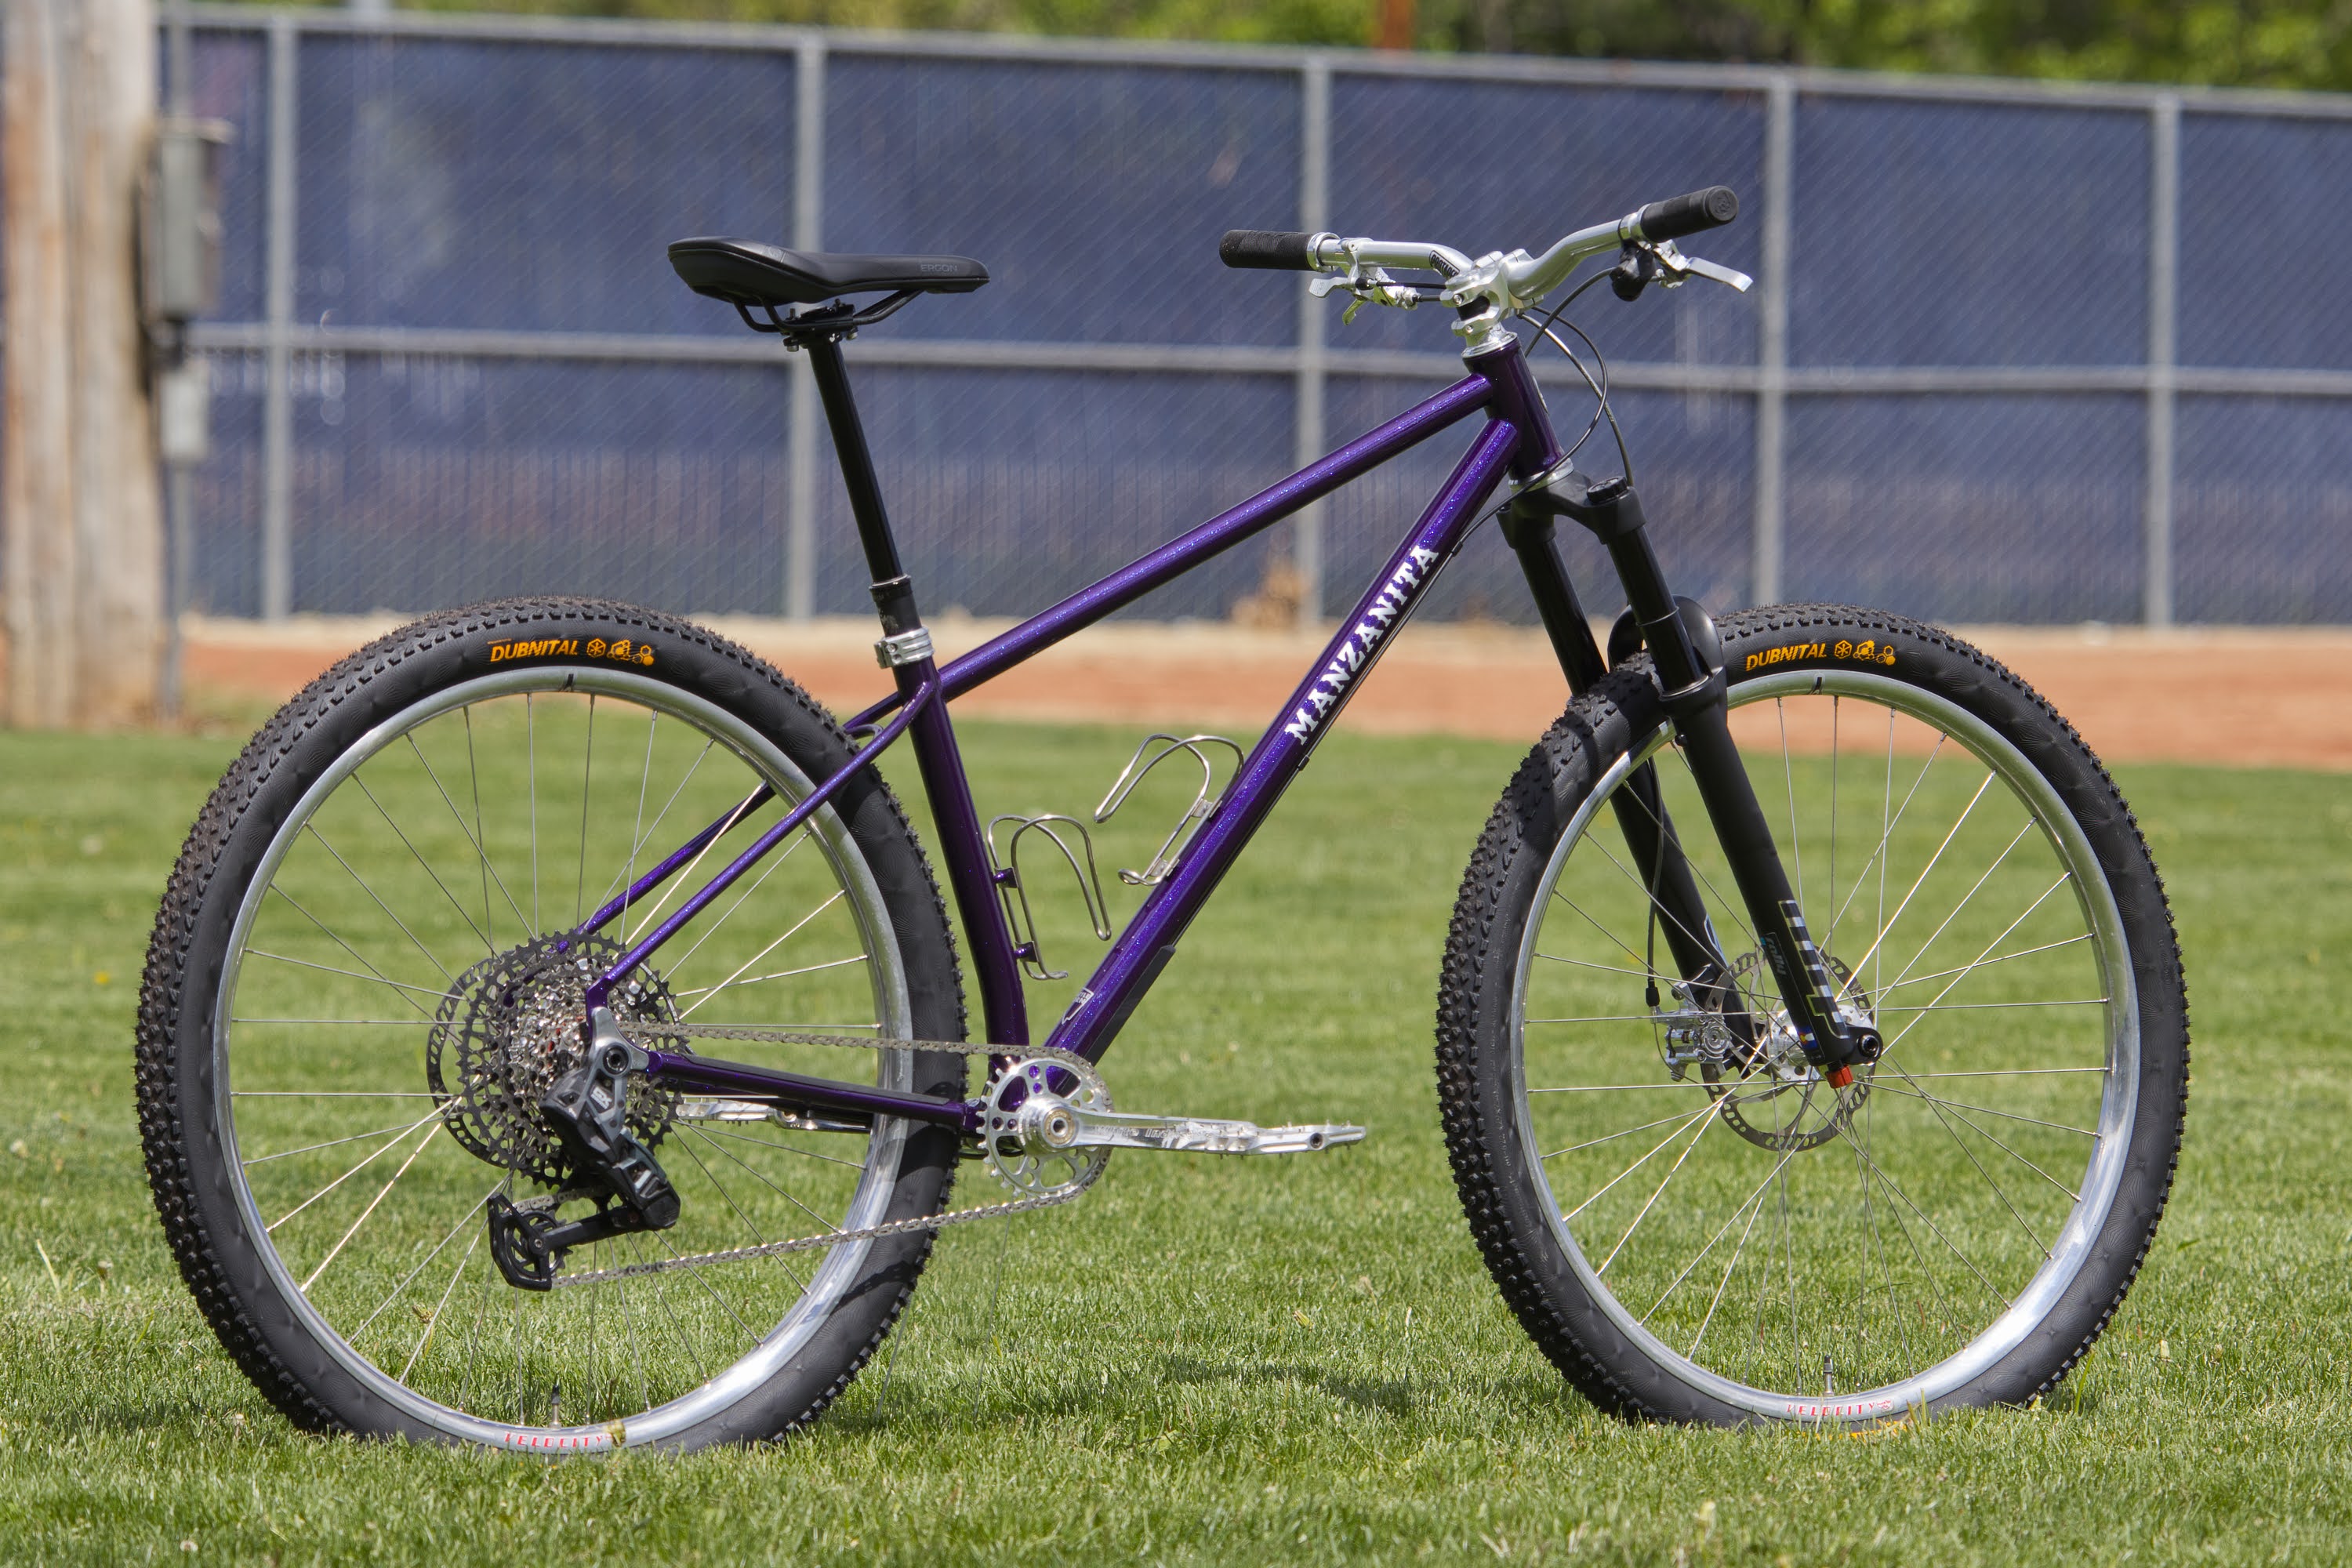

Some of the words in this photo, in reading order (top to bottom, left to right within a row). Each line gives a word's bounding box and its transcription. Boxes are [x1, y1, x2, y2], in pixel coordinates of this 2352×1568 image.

[491, 639, 579, 662] DUBNITAL
[1284, 545, 1439, 746] MANZANITA
[1745, 643, 1828, 672] DUBNITAL
[504, 1432, 604, 1448] VELOCITY
